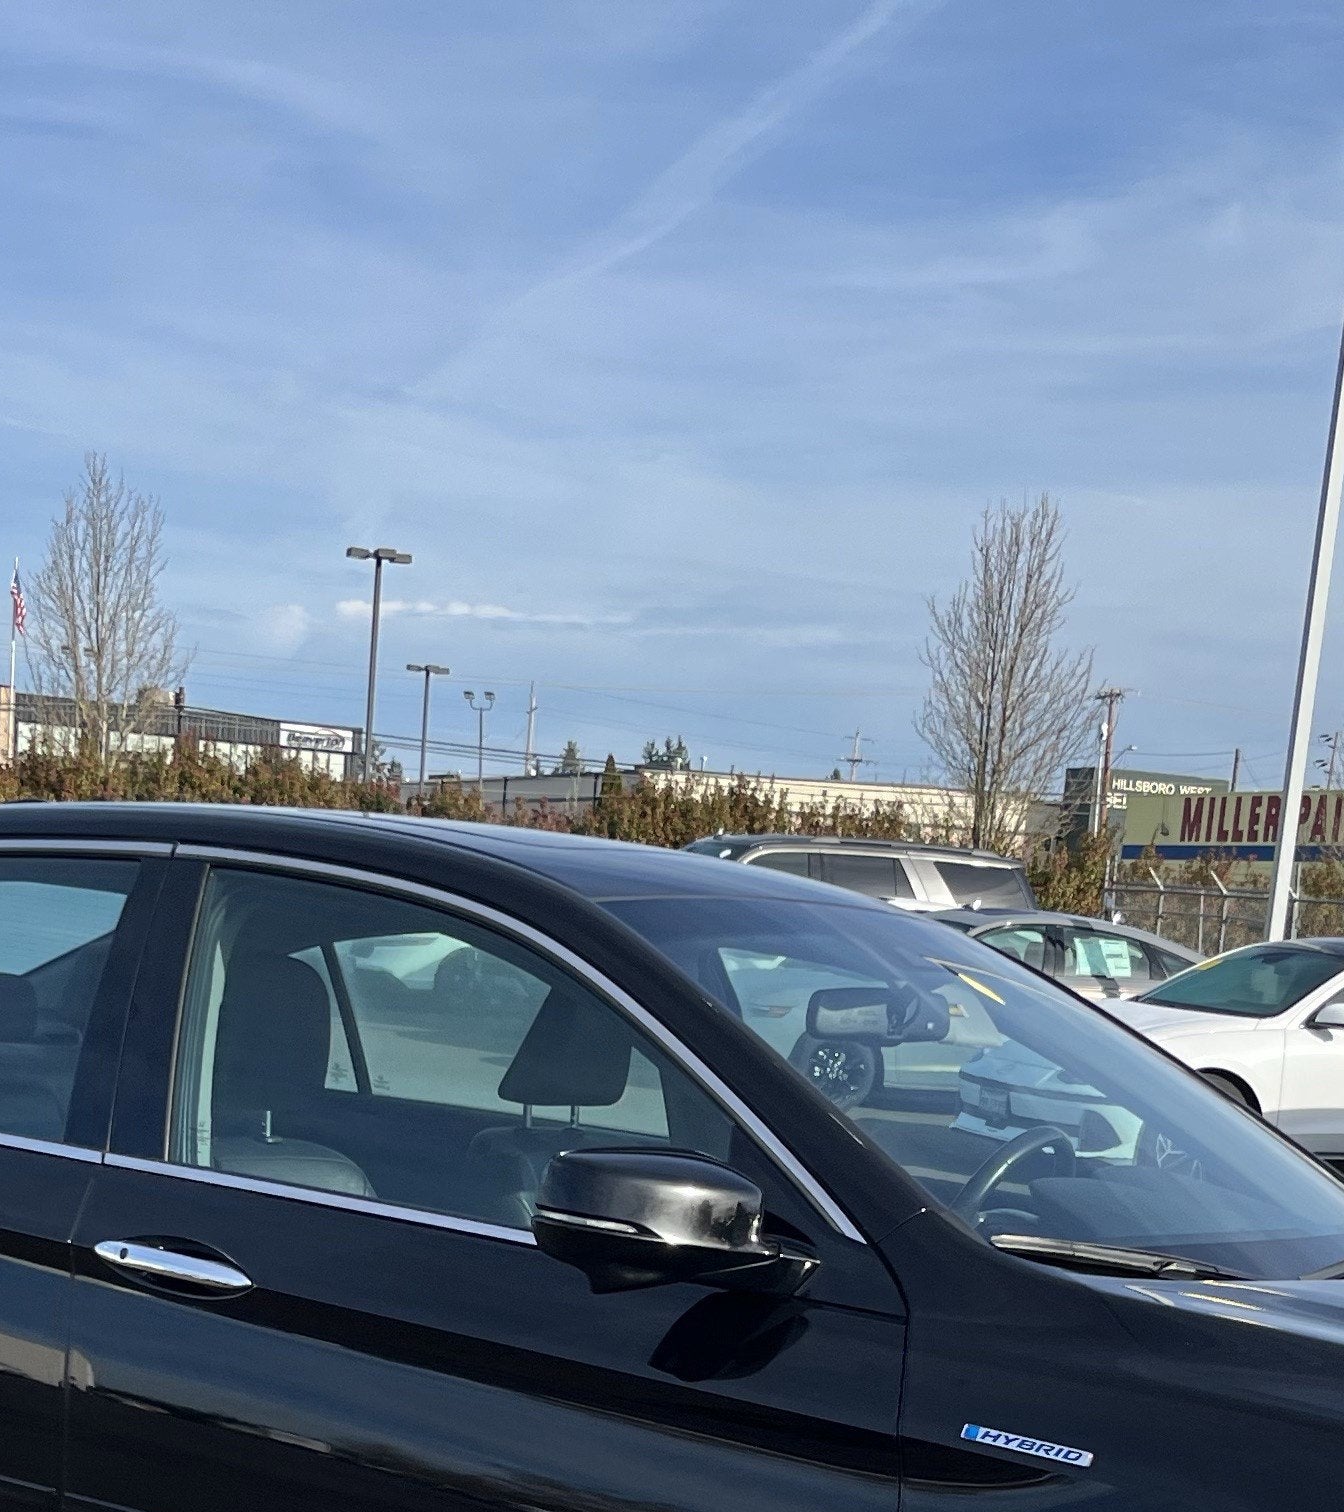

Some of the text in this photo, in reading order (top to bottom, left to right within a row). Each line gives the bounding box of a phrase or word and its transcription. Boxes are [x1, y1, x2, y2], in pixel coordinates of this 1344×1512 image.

[1112, 779, 1212, 795] HILLSBORO WEST
[1180, 795, 1282, 842] MILLER
[980, 1430, 1083, 1461] HYBRID
